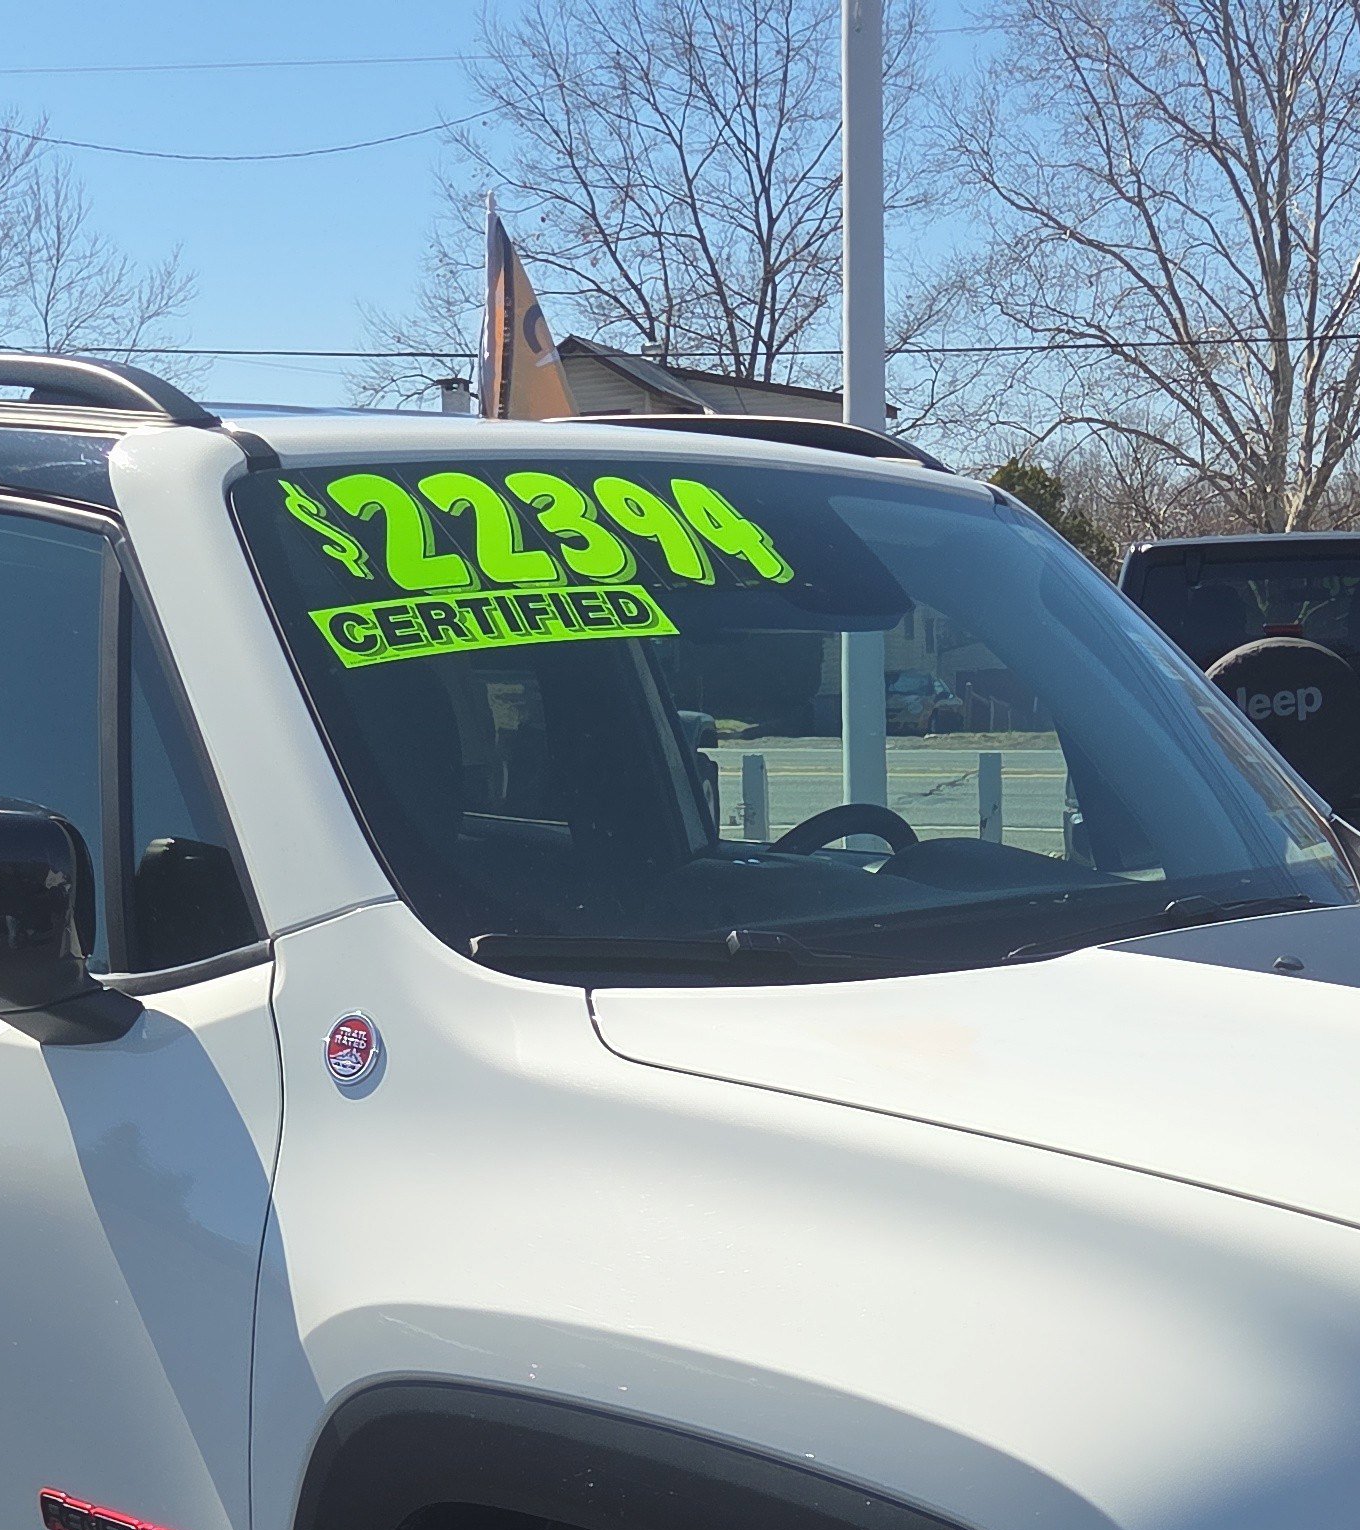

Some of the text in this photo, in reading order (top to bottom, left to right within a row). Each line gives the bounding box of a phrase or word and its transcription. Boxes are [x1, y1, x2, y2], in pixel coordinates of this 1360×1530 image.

[278, 471, 794, 593] $22394
[328, 590, 660, 657] CERTIFIED
[334, 1034, 366, 1049] RATED
[340, 1026, 367, 1040] TRAIL
